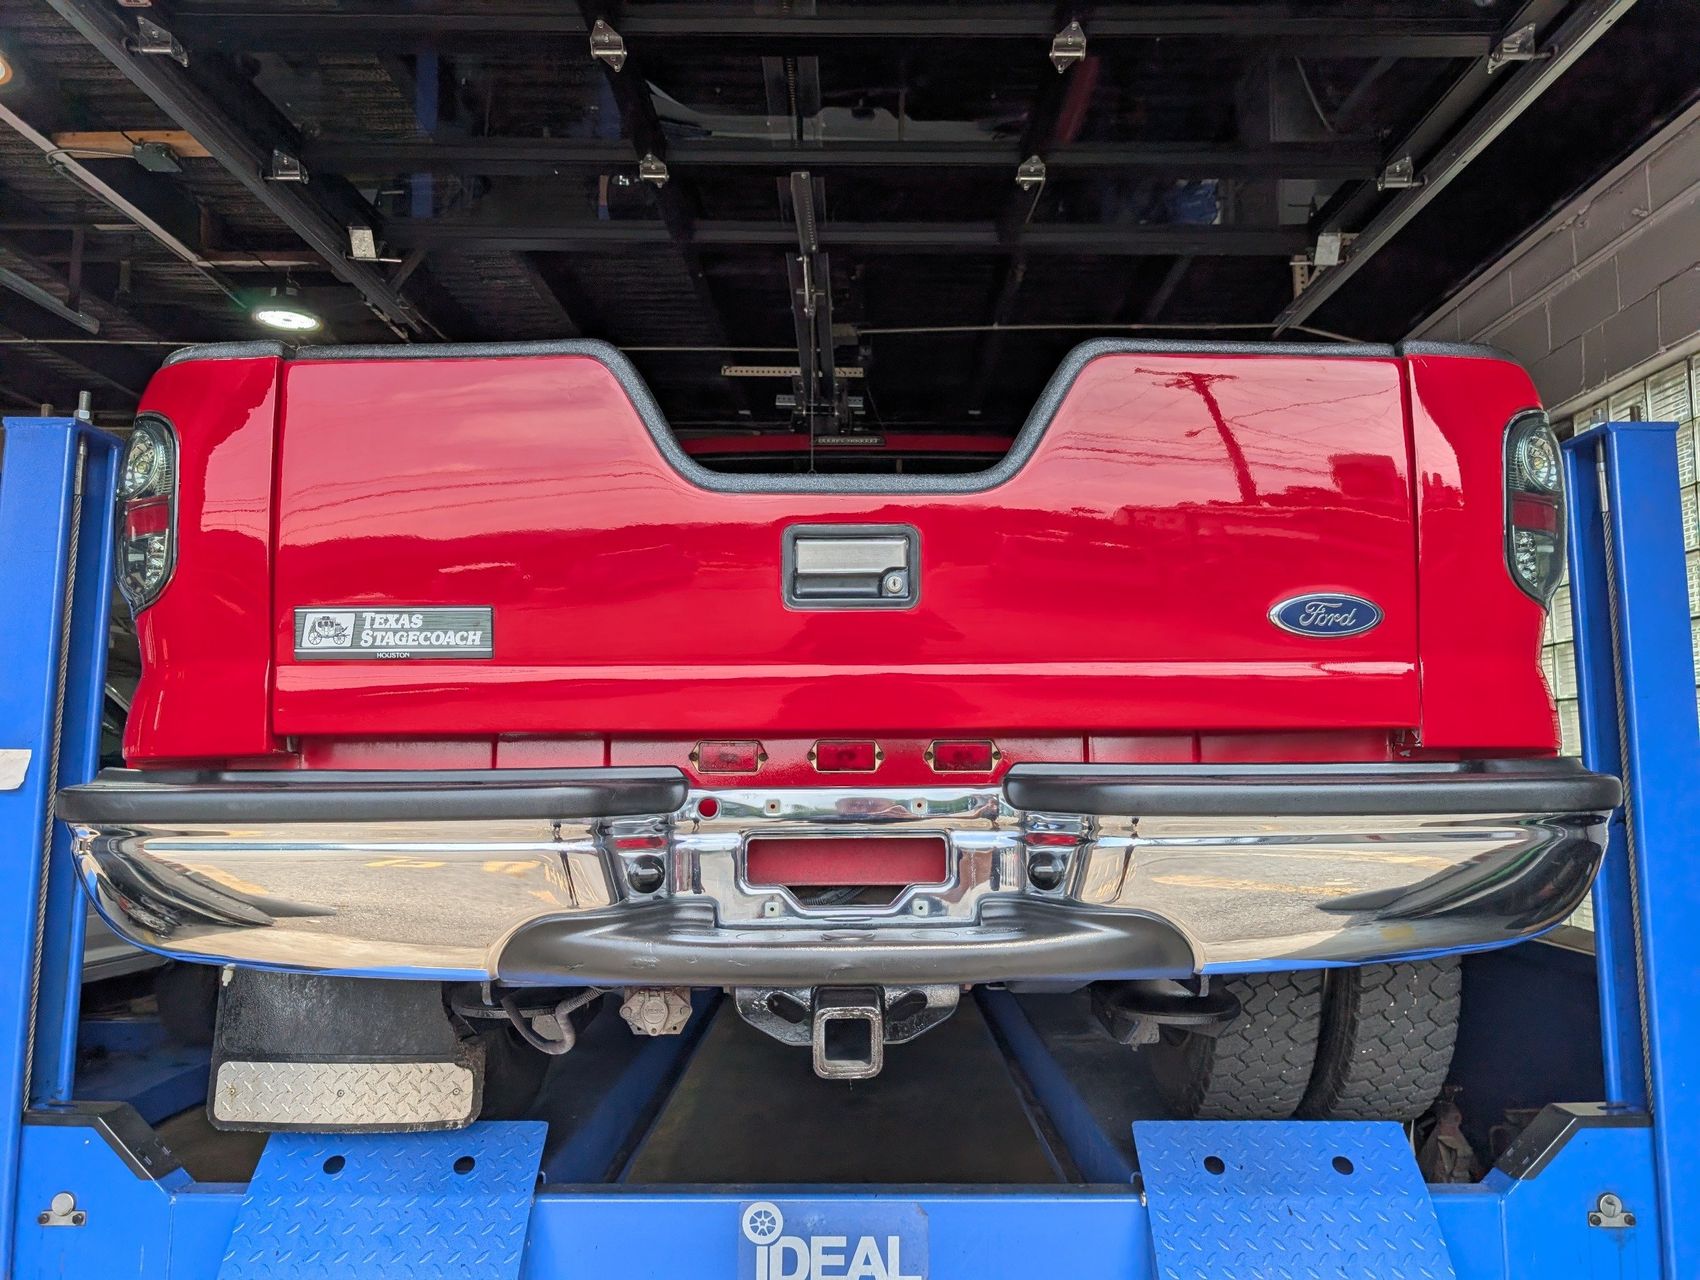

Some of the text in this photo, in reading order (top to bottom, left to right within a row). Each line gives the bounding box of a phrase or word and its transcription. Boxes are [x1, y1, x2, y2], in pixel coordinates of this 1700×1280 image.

[361, 612, 423, 629] TEXAS
[1298, 601, 1358, 627] Ford
[360, 630, 482, 647] STAGECOACH
[376, 651, 410, 659] HOUSTON
